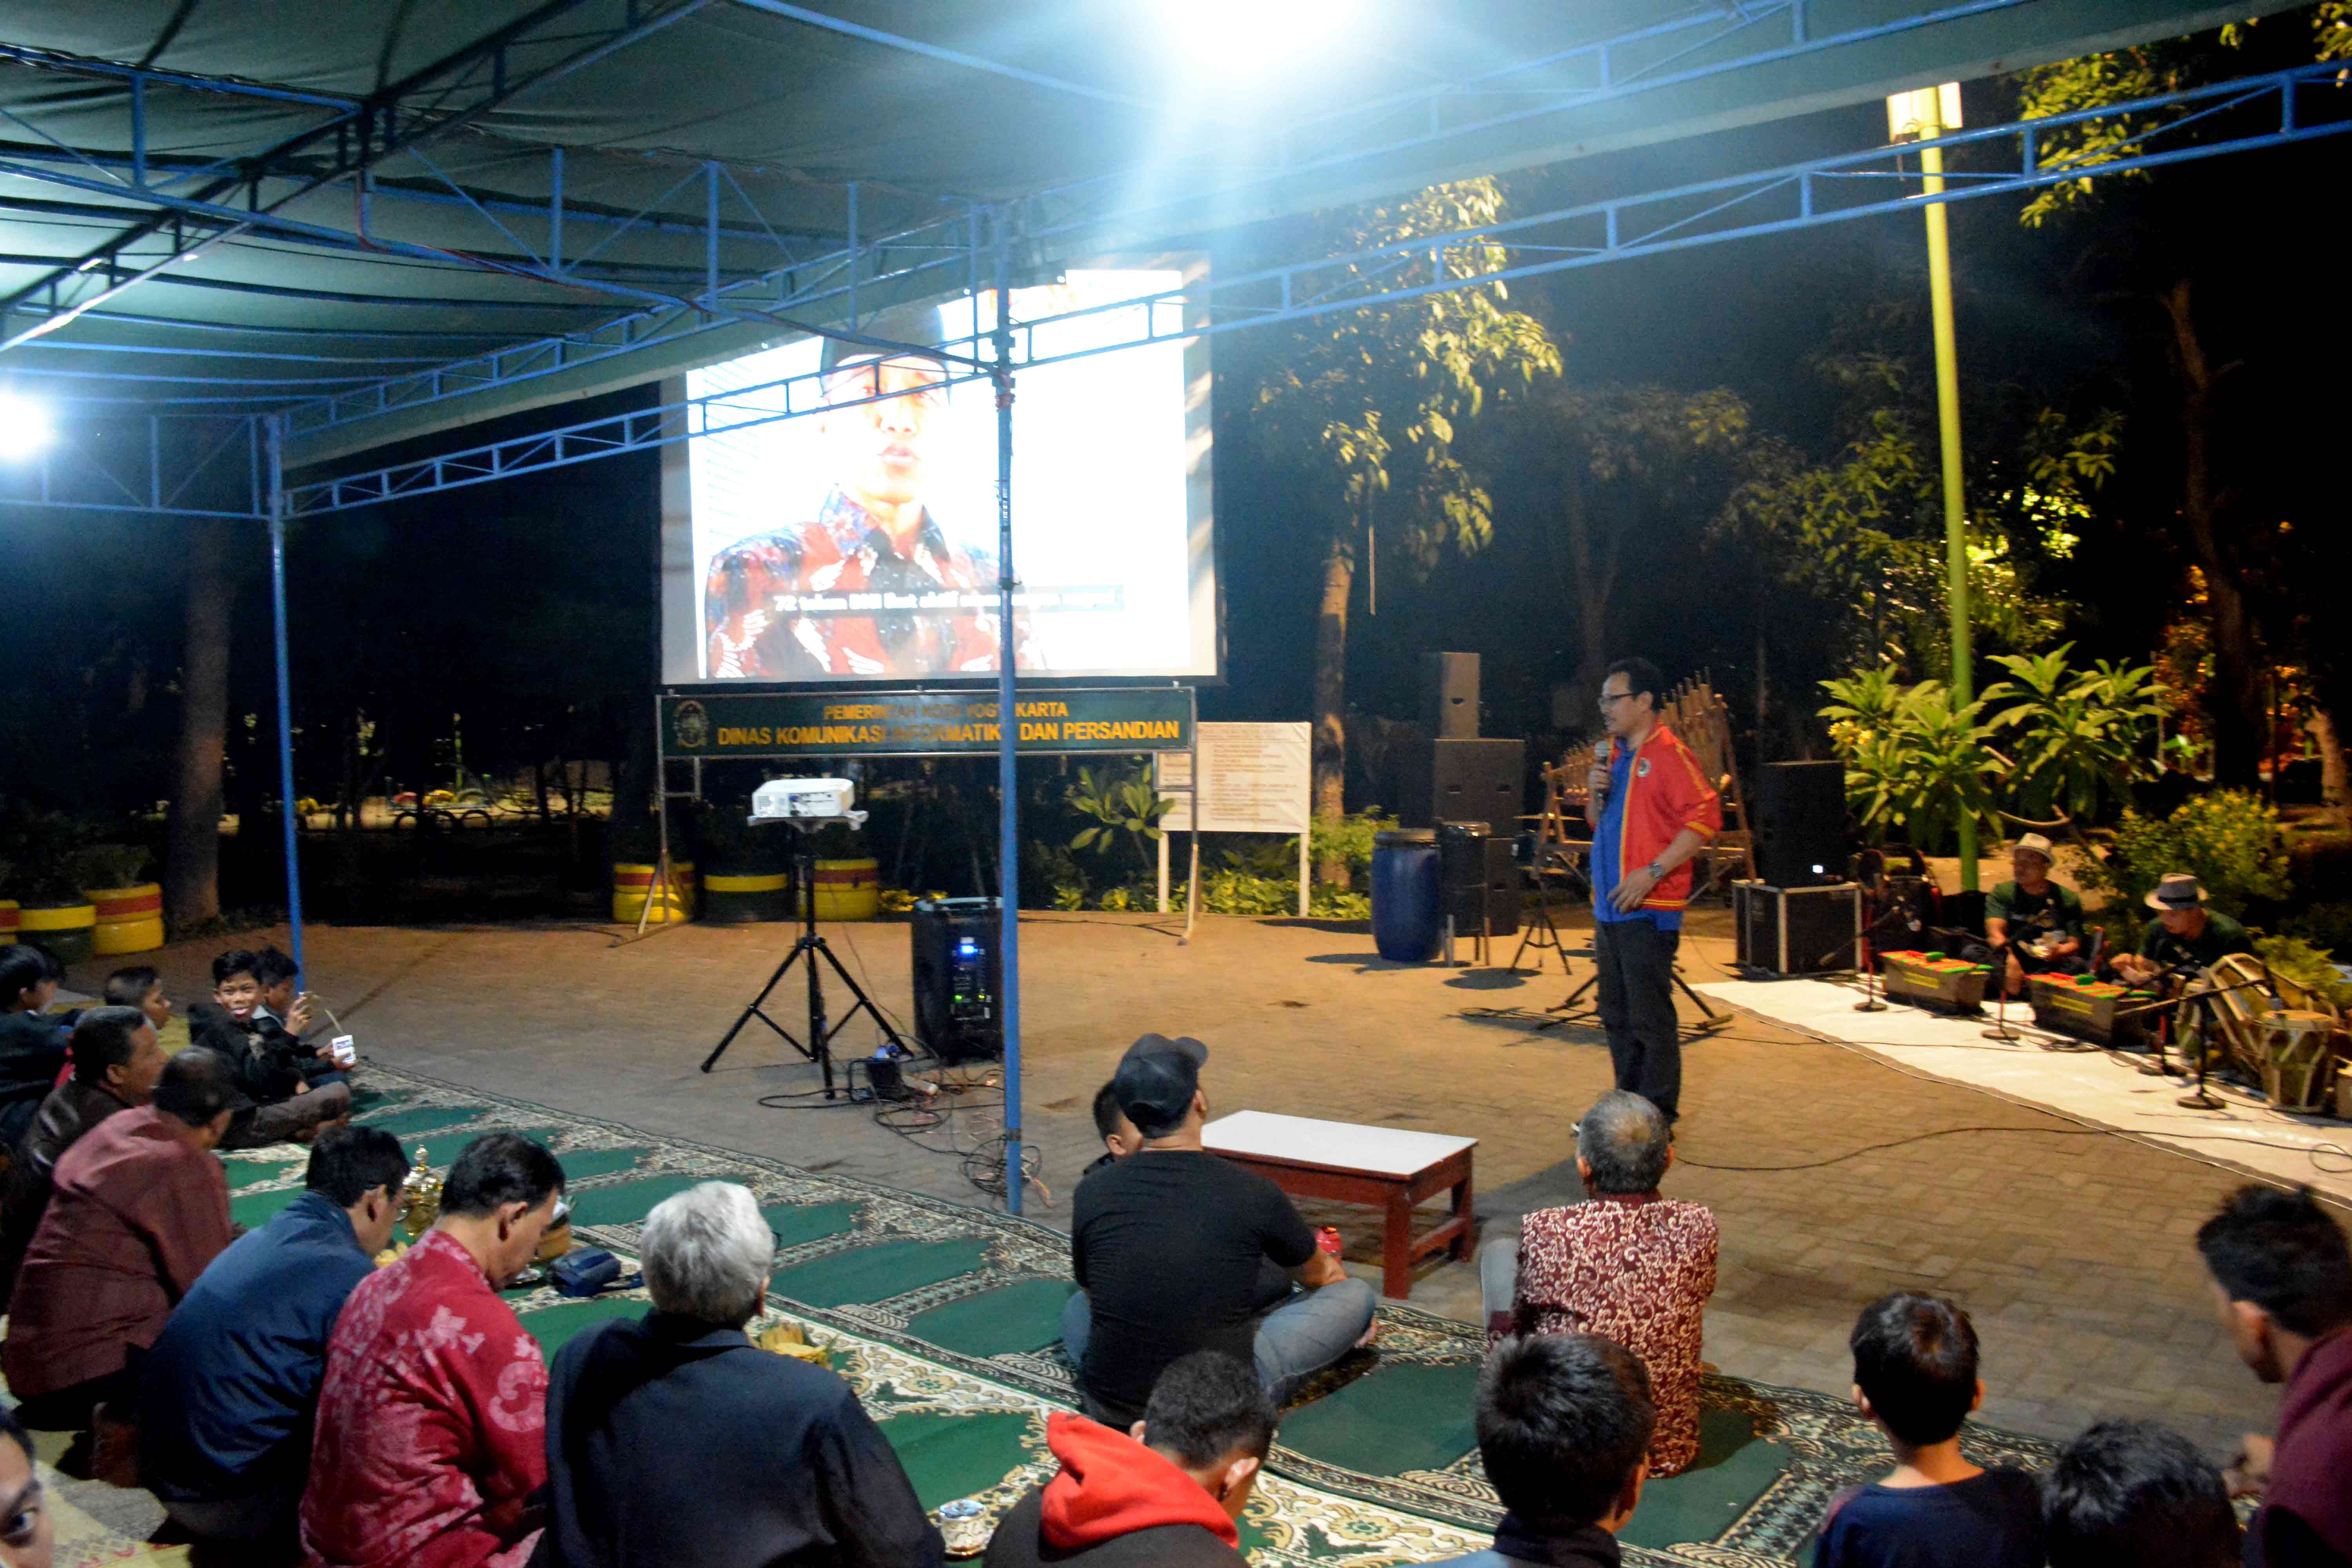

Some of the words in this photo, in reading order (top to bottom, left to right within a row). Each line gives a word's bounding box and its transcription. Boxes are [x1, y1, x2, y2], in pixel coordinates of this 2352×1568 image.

[718, 727, 772, 745] DINAS
[891, 723, 1002, 741] INFORMATIK
[1020, 722, 1058, 740] DAN
[1063, 720, 1179, 740] PERSANDIAN
